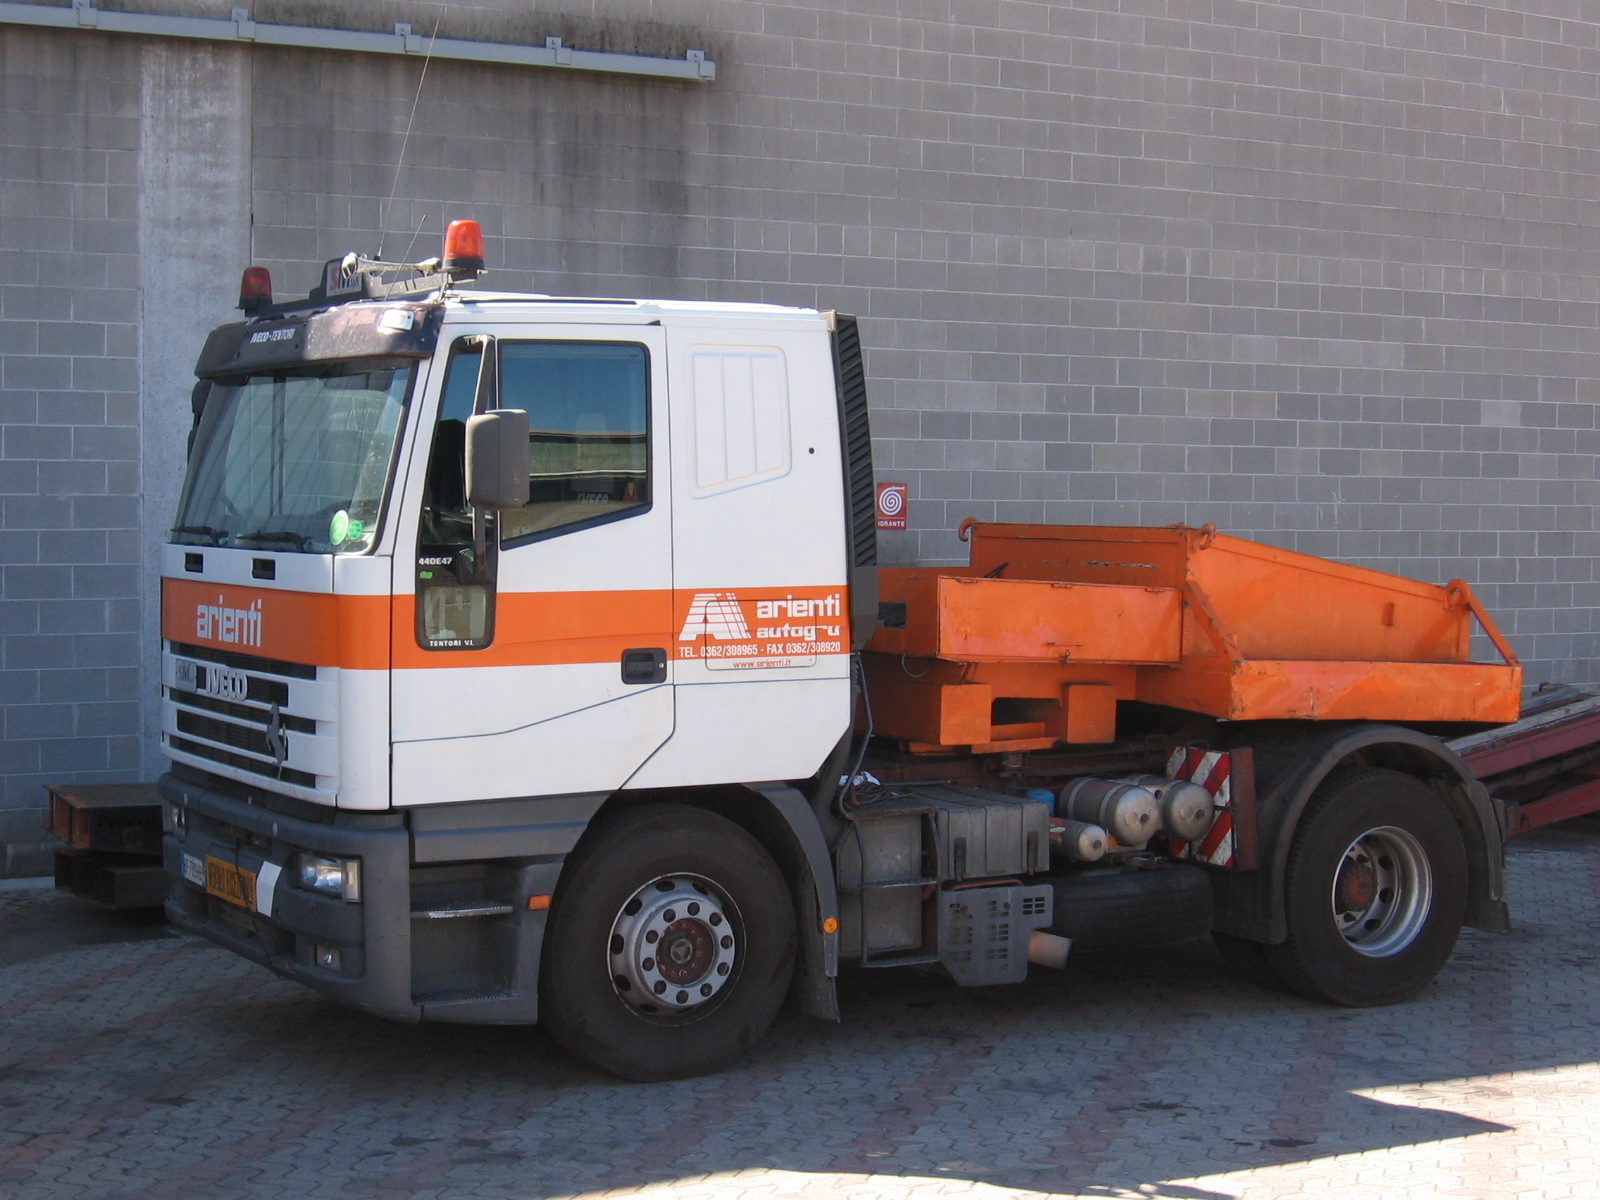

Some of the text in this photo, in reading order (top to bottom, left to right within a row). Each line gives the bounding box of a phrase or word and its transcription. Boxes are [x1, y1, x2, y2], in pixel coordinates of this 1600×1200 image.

[418, 557, 452, 565] 440E47
[756, 593, 841, 619] arienti
[196, 594, 262, 647] arienti
[756, 623, 841, 642] autogru
[678, 646, 698, 658] TEL.
[700, 644, 758, 657] 0362/308965
[766, 643, 784, 655] FAX
[786, 641, 841, 654] 0362/308920
[733, 659, 791, 669] www.arienti.it
[205, 665, 248, 701] IVECO
